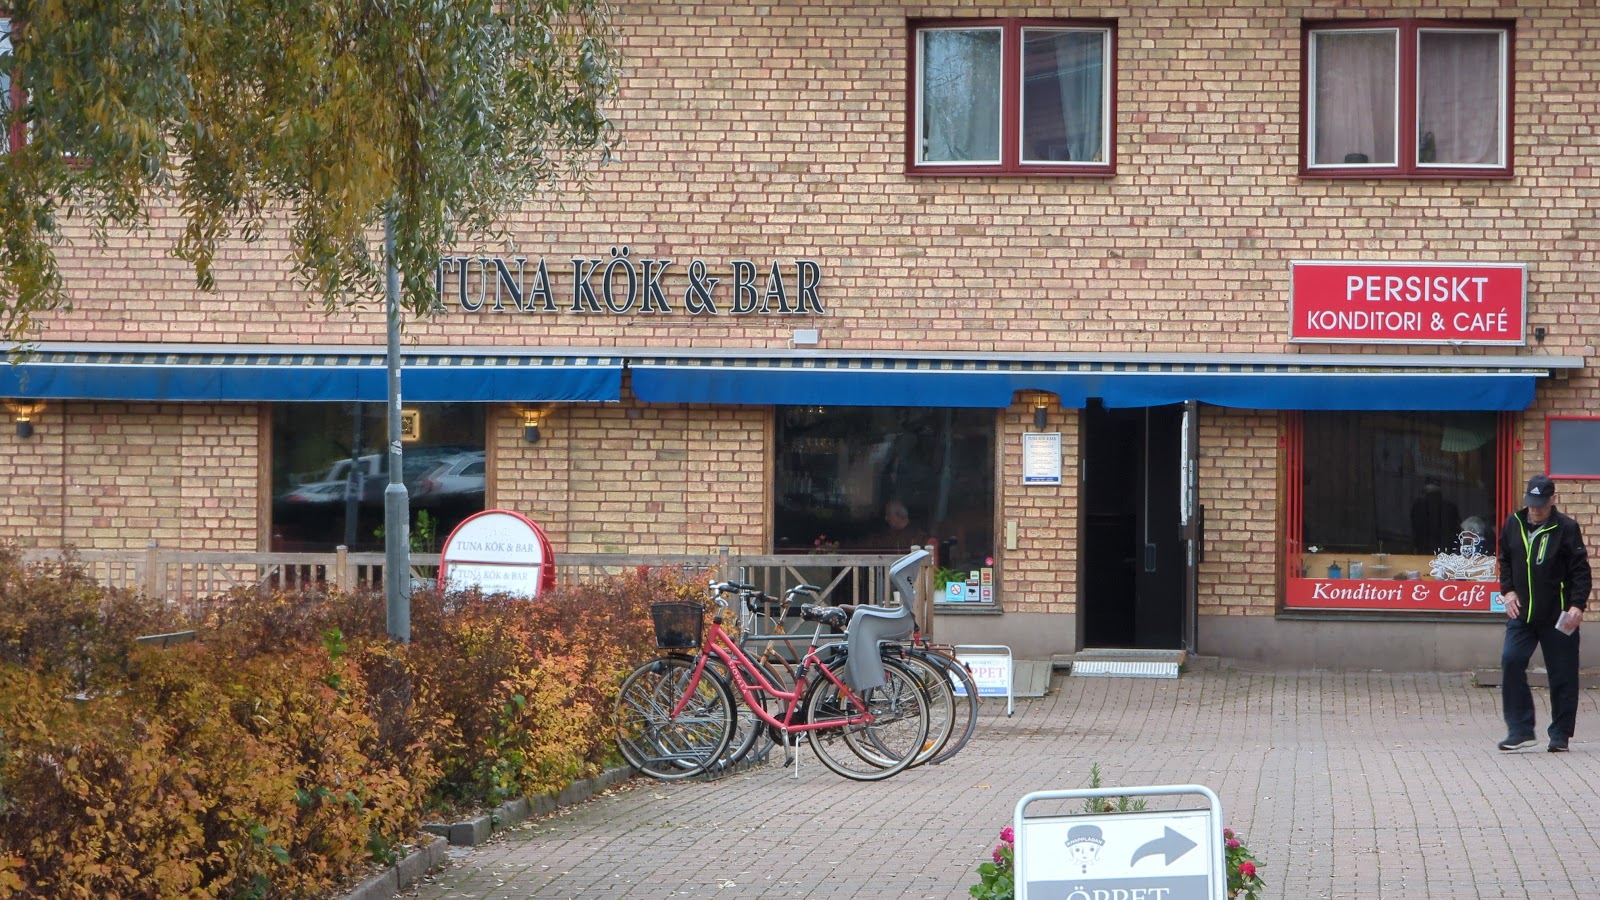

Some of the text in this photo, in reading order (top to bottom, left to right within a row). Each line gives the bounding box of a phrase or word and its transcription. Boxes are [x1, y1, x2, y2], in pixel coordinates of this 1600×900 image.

[433, 246, 826, 315] TUNA KÖK & BAR
[1346, 276, 1489, 303] PERSISKT
[1307, 307, 1508, 332] KONDITORI & CAFÉ
[456, 541, 534, 553] TUNA KÖK & BAR
[458, 570, 528, 581] TUNA KÖK & BAR
[1312, 583, 1486, 607] Konditori & Café
